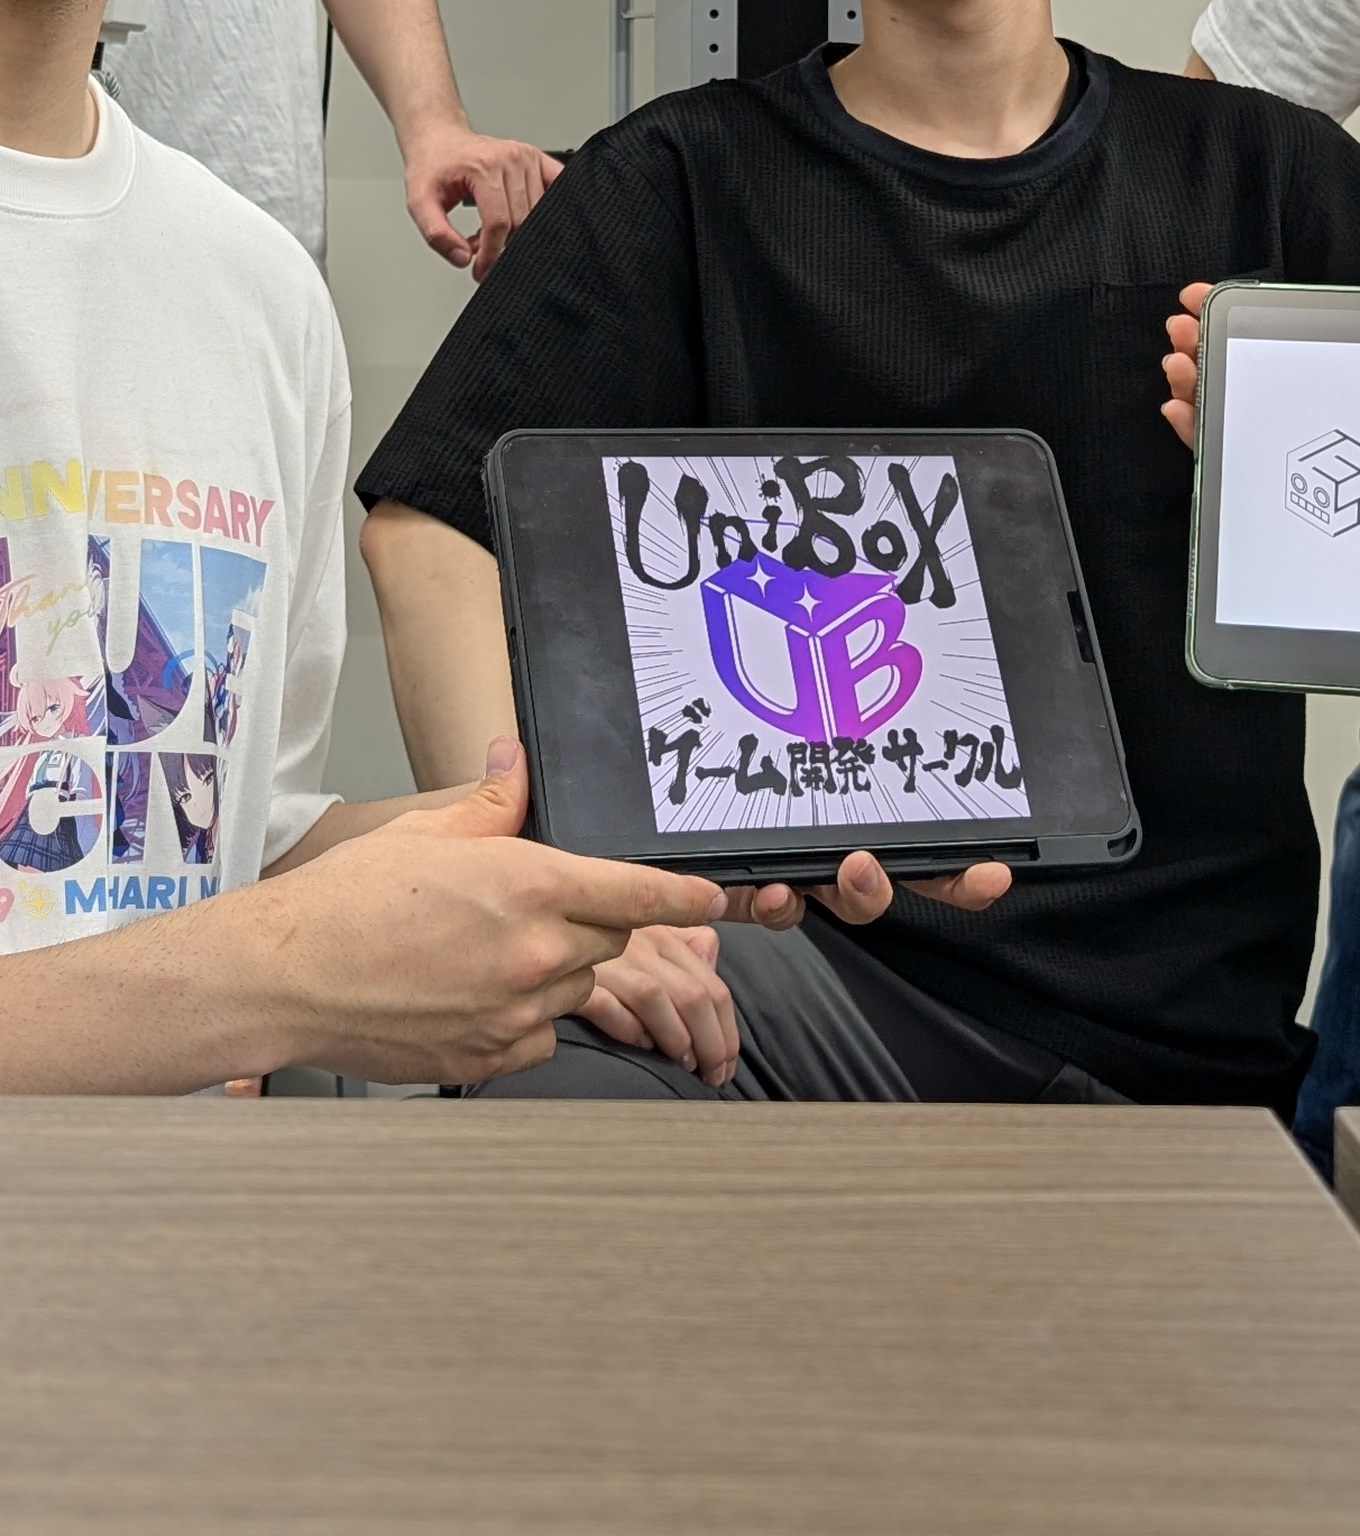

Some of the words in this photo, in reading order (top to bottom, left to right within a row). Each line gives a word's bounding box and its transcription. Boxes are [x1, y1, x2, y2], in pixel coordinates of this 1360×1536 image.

[648, 697, 1022, 805] ゲーム開発サークル
